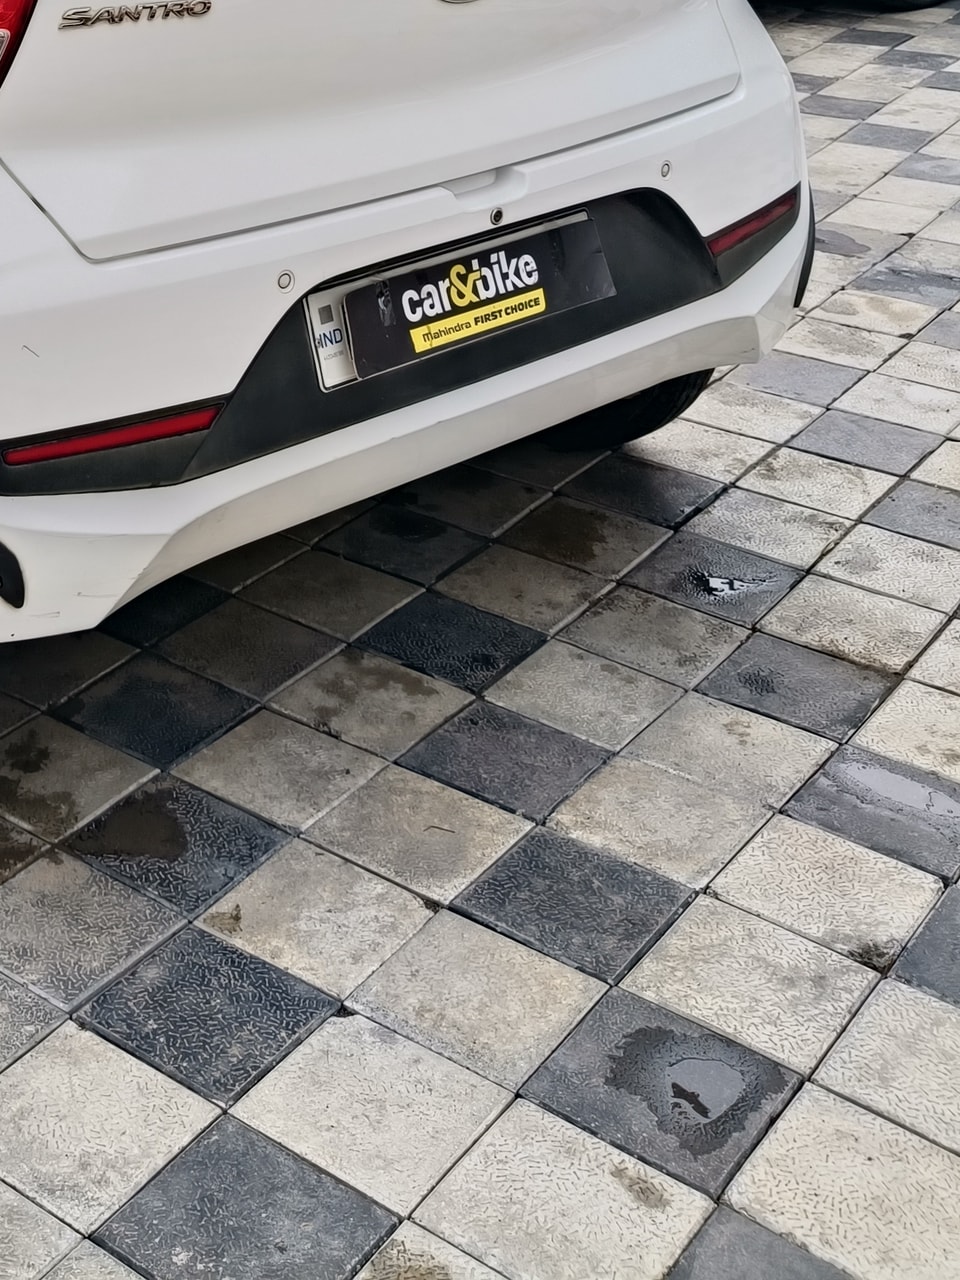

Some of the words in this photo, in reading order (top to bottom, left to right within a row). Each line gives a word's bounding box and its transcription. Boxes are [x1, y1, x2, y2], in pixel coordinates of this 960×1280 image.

[401, 250, 539, 323] car&bike
[473, 309, 503, 327] FIRST
[504, 297, 541, 316] CHOICE
[319, 328, 343, 349] IND
